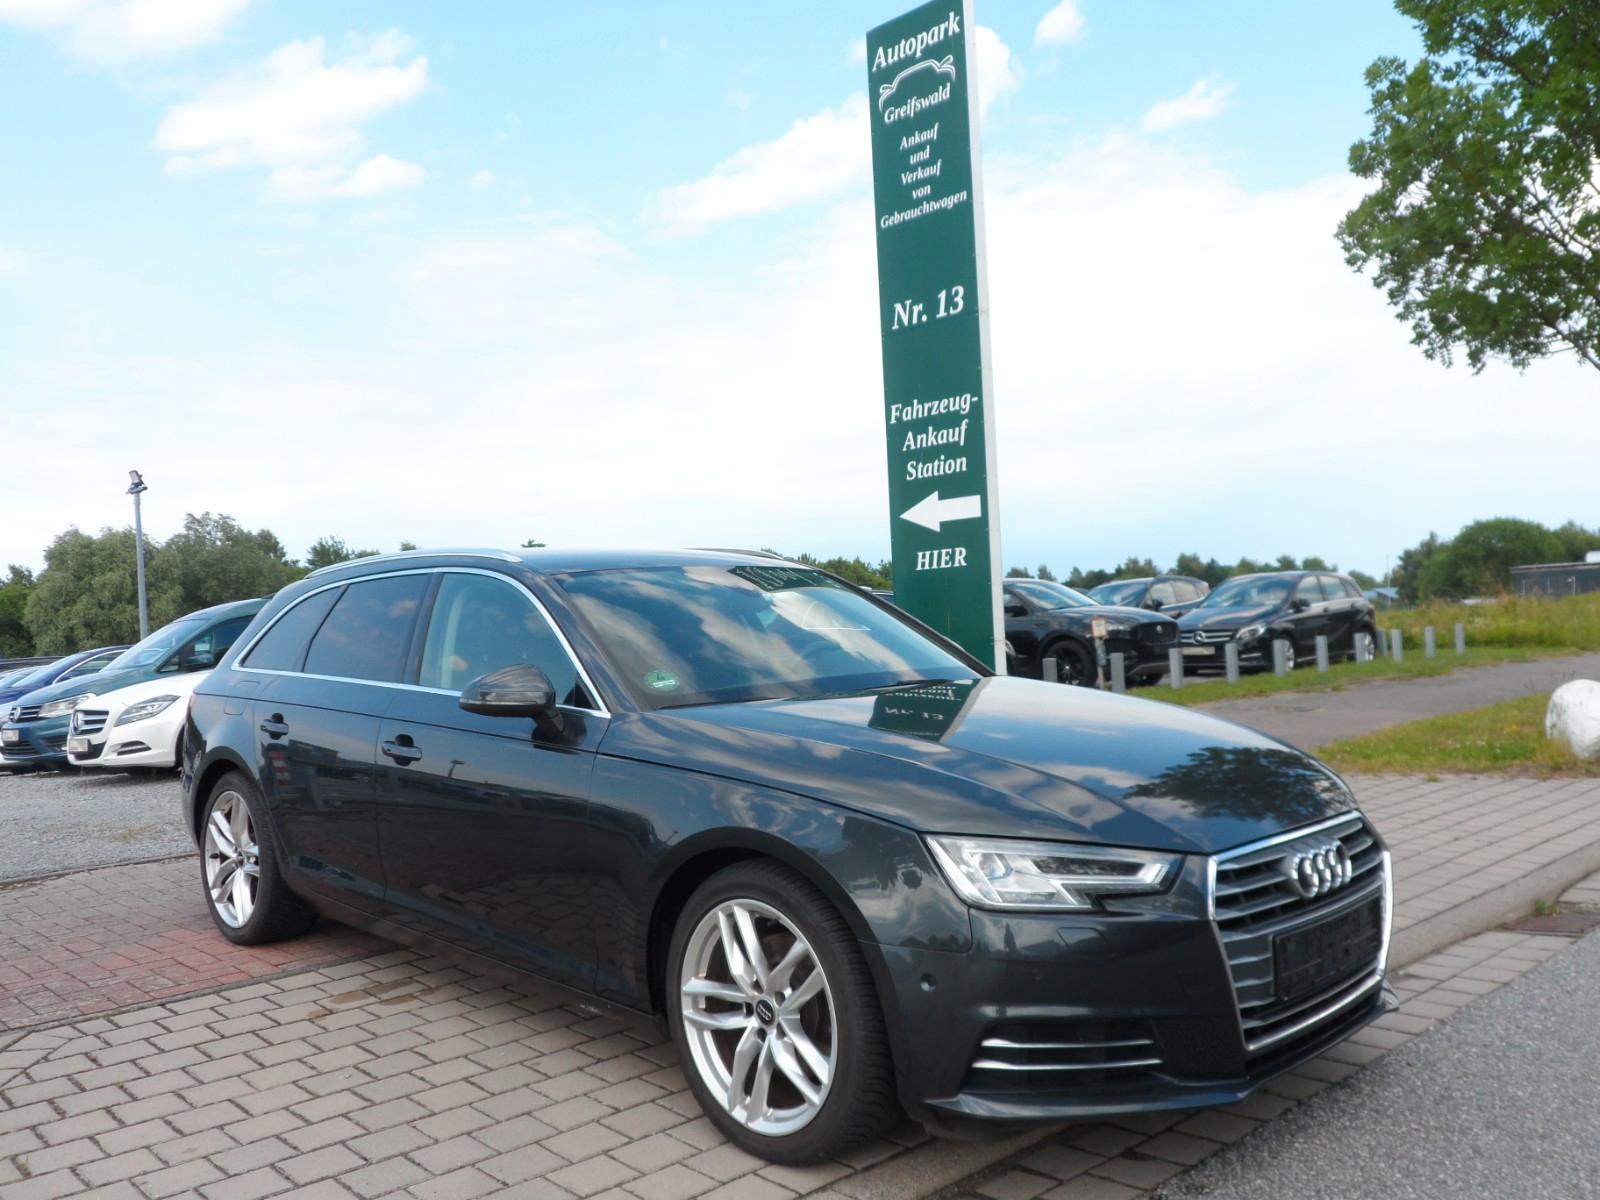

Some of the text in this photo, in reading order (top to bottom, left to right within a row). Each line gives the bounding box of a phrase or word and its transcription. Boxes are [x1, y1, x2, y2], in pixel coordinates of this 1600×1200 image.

[872, 11, 960, 72] Autopark
[884, 82, 951, 124] Greifswald
[900, 122, 939, 150] Ankauf
[910, 144, 930, 165] und
[901, 158, 942, 185] Verkauf
[912, 184, 931, 200] von
[880, 190, 967, 229] Gebrauchtwagen
[892, 285, 964, 330] Nr. 13
[890, 393, 978, 424] Fahrzeug-
[903, 419, 968, 451] Ankauf
[906, 454, 967, 480] Station
[916, 547, 967, 571] HIER
